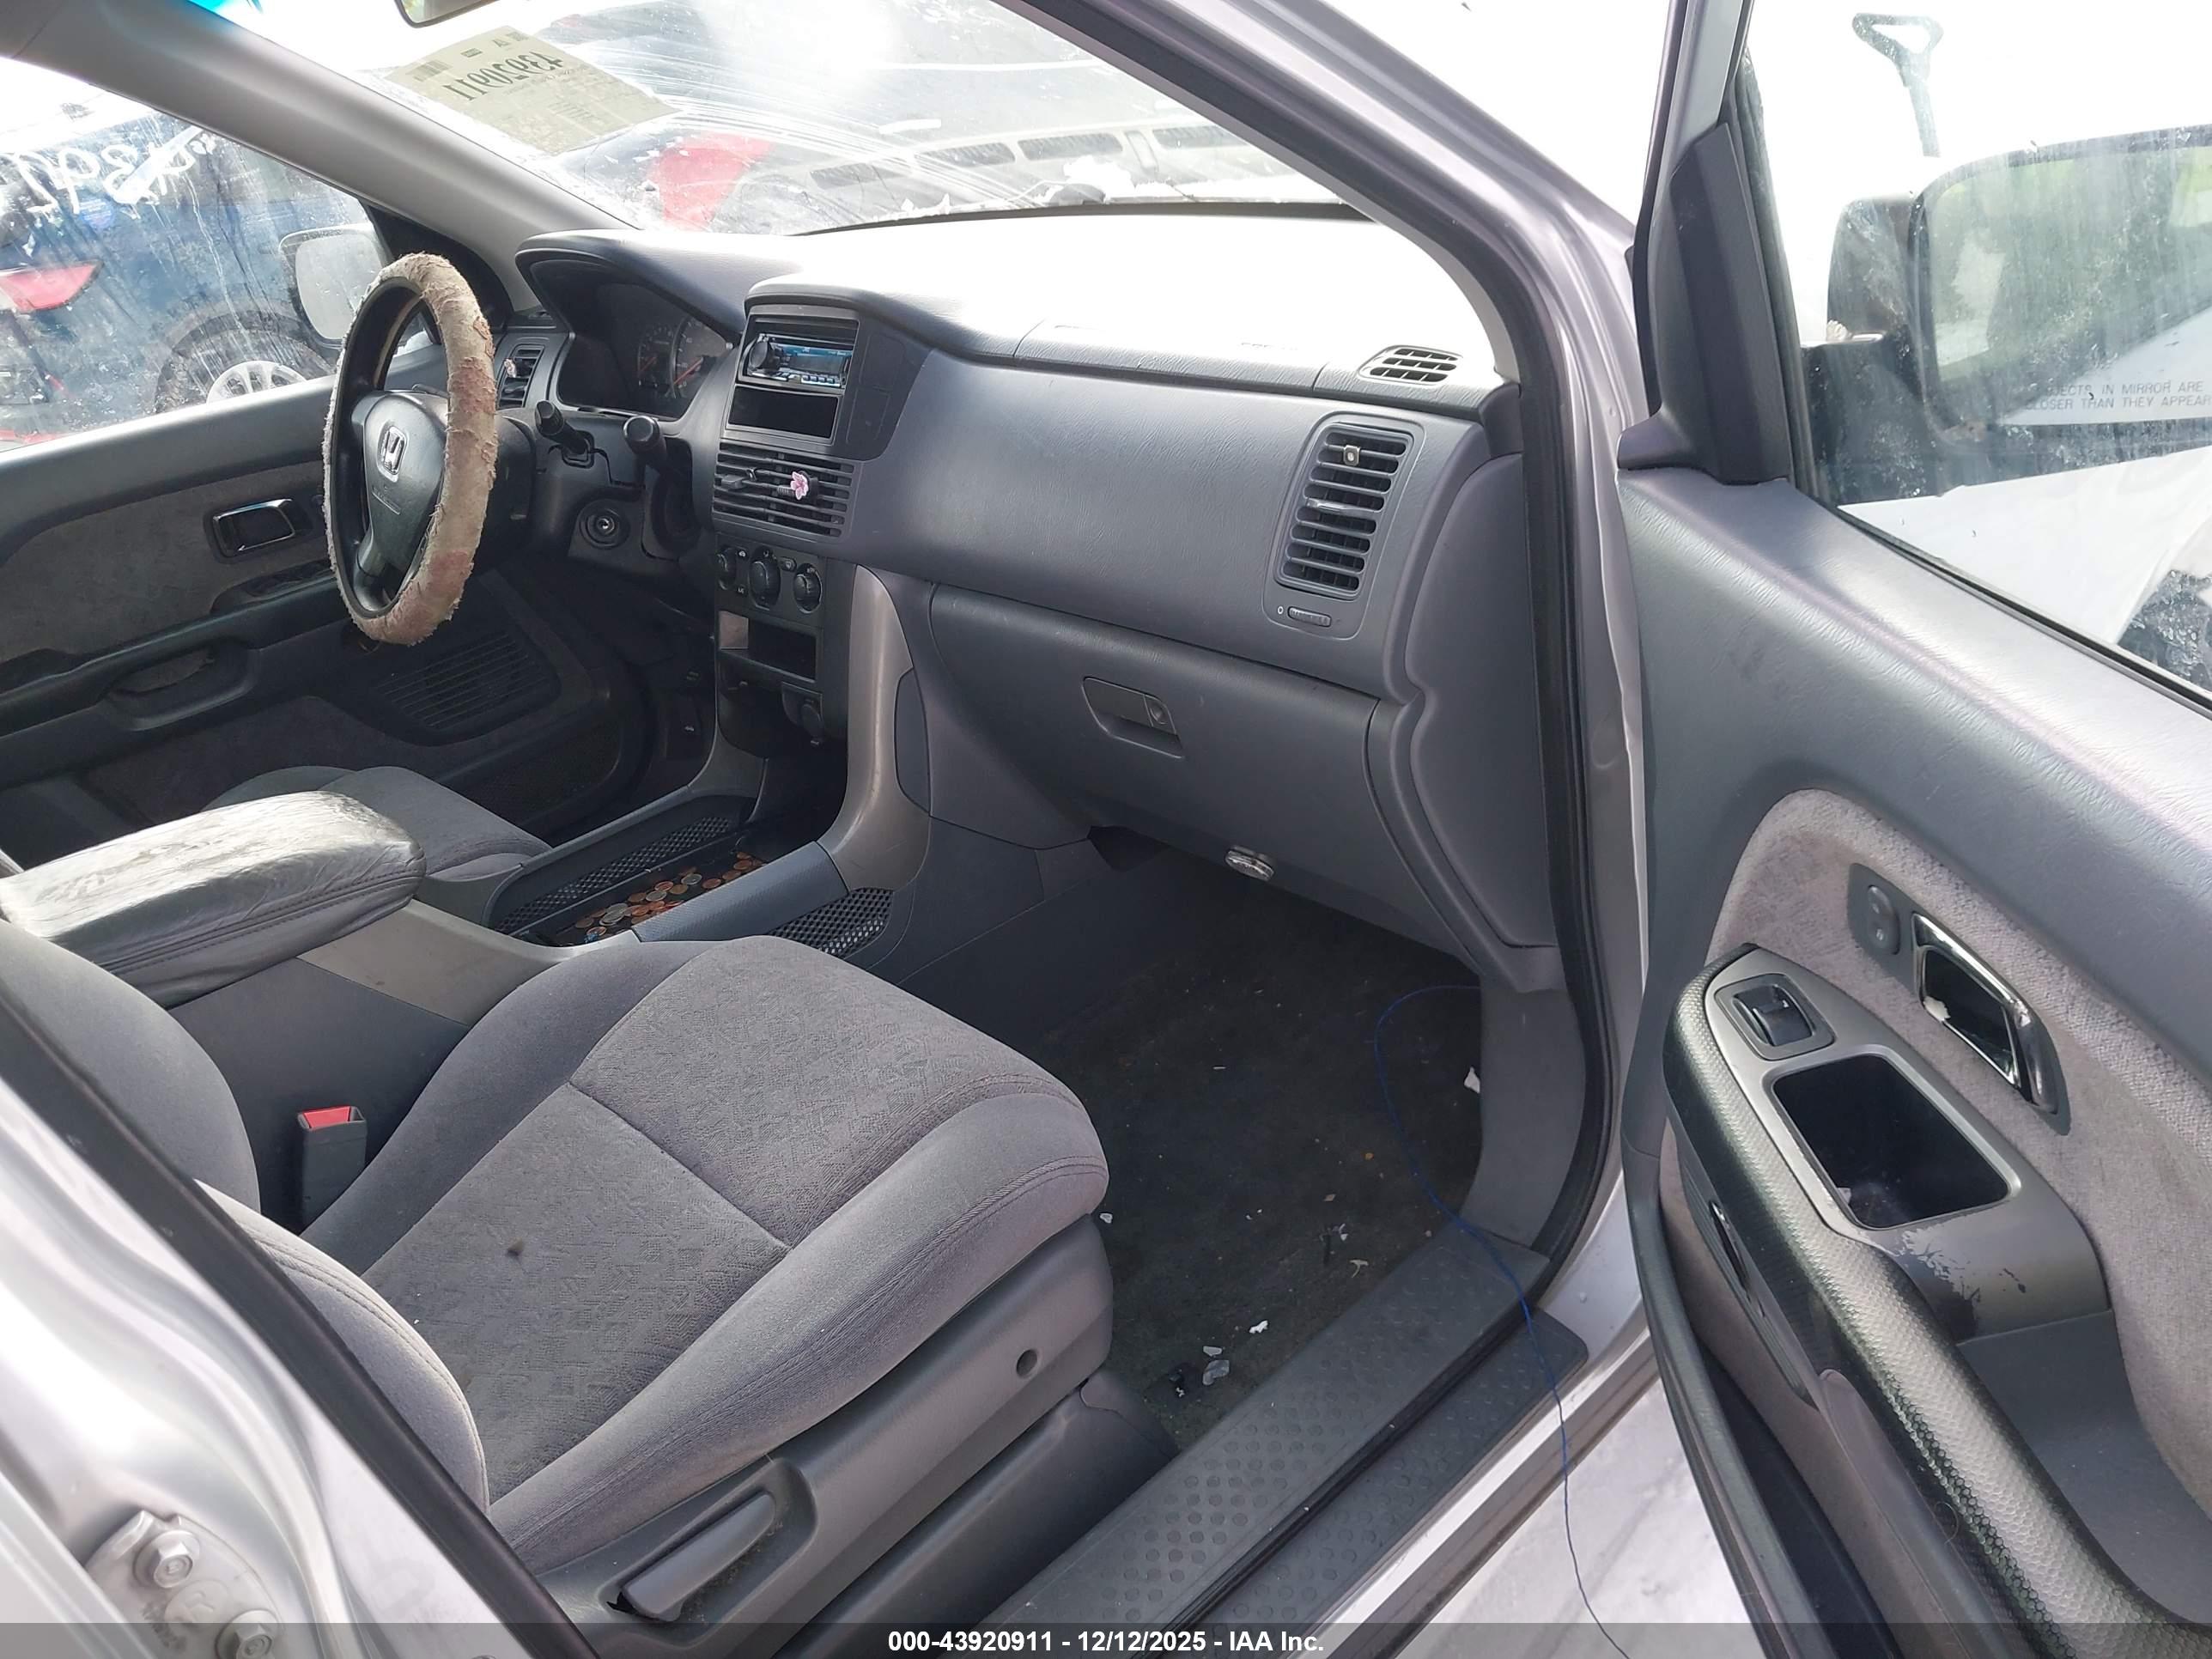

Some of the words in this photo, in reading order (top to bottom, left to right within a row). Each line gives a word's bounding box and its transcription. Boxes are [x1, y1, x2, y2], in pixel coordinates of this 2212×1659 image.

[2101, 383, 2114, 394] IN
[2121, 380, 2172, 394] MIRROR
[2177, 380, 2204, 392] ARE
[2081, 397, 2115, 409] THAN
[2122, 396, 2154, 408] THEY
